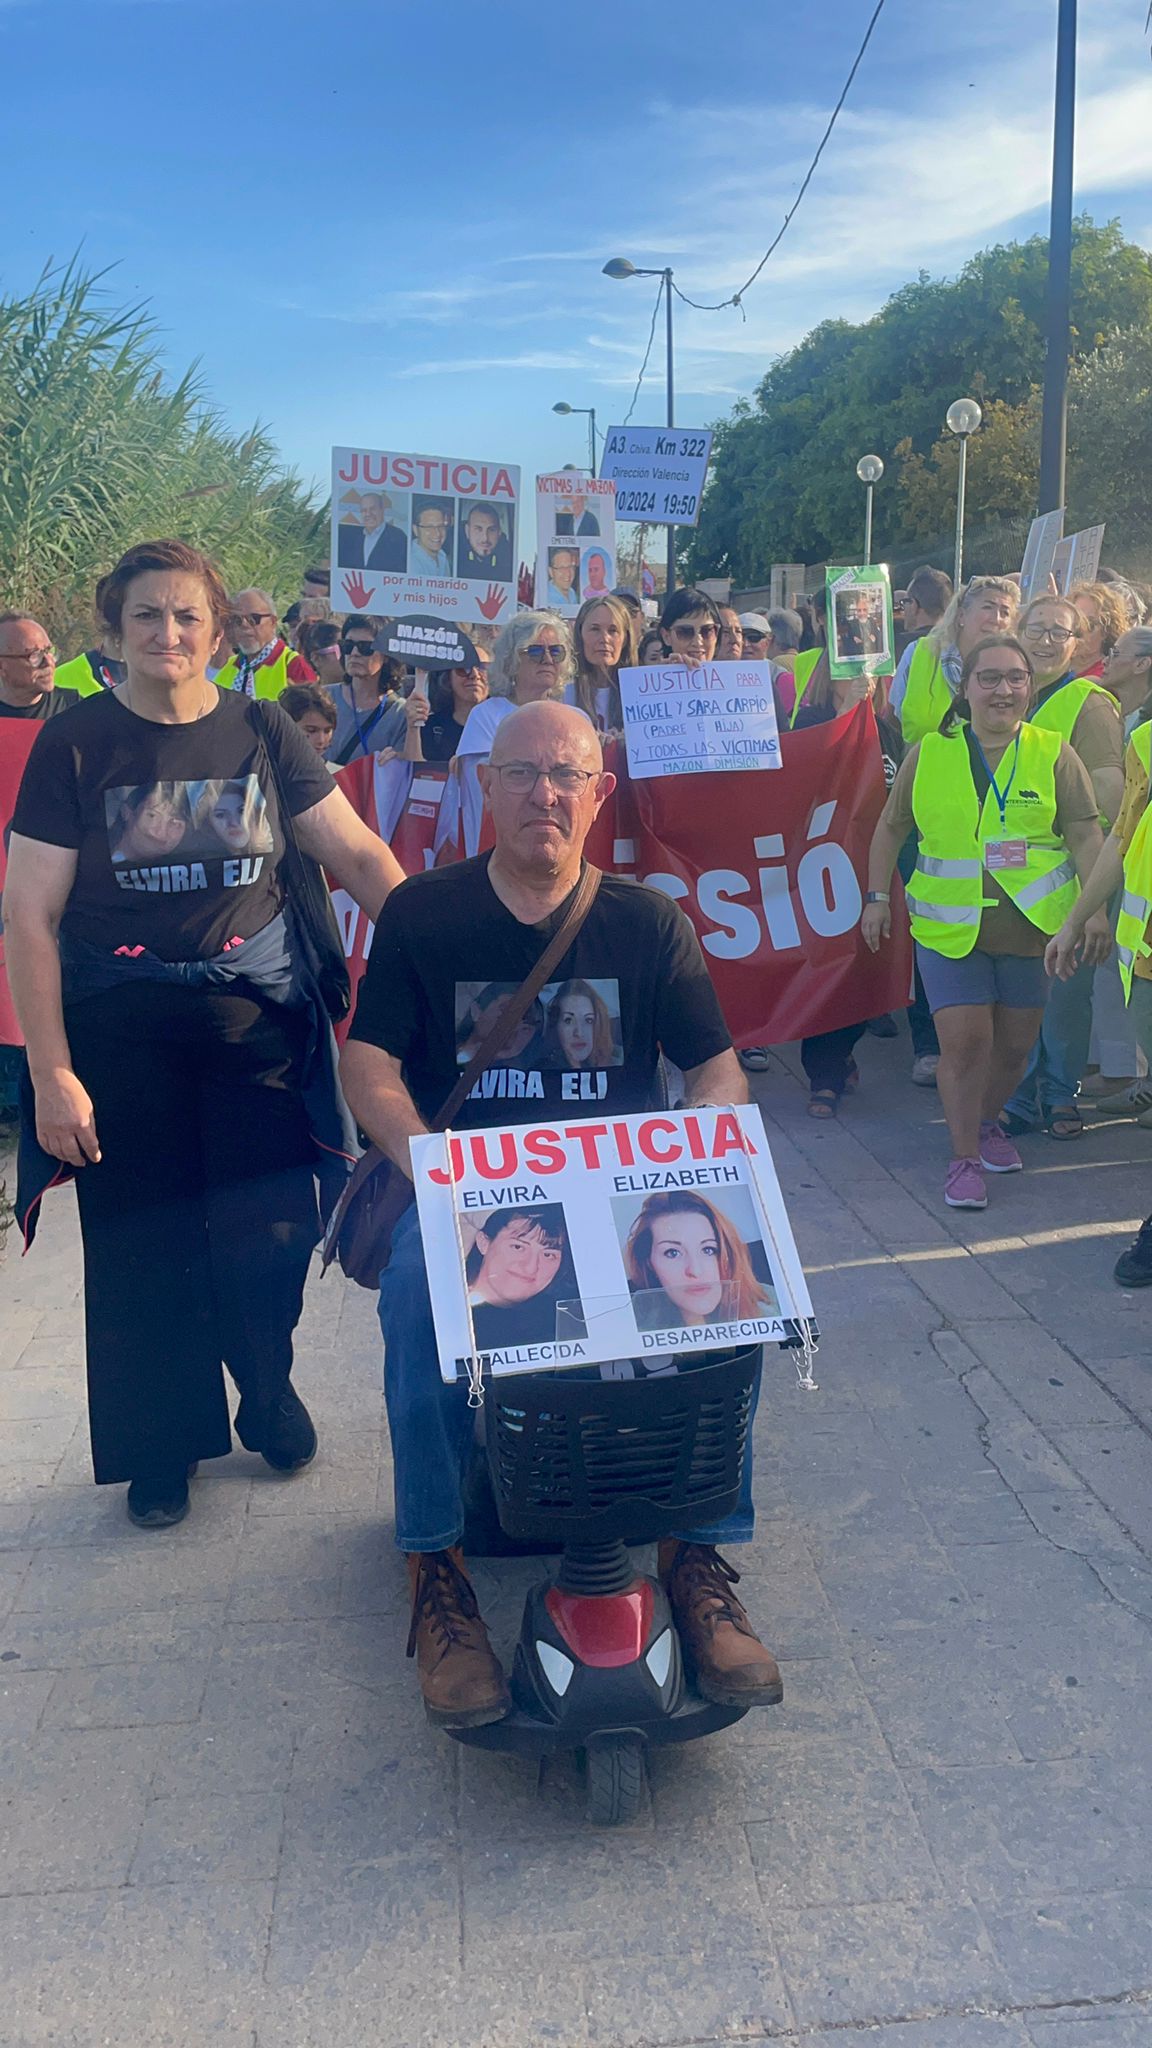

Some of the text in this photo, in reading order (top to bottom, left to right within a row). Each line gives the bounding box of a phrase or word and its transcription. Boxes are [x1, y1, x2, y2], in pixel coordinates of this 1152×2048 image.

[655, 437, 676, 456] Km
[680, 439, 706, 458] 322
[338, 453, 516, 498] JUSTICIA
[612, 467, 690, 482] Dirección Valencia
[663, 494, 697, 516] 19:50
[383, 576, 469, 591] por mi marido
[393, 592, 458, 607] y mis hijos
[397, 624, 458, 645] MAZÓN
[388, 639, 465, 662] DIMISSIÓ
[737, 672, 762, 686] PARA
[687, 699, 722, 716] SARA
[643, 723, 687, 740] (PADRE
[697, 722, 704, 733] E
[648, 743, 688, 759] TODAS
[694, 741, 716, 754] LAS
[115, 857, 264, 893] ELVIRA ELI
[460, 1069, 608, 1100] LVIRA ELI
[427, 1113, 758, 1185] JUSTICIA
[613, 1166, 740, 1193] ELIZABETH
[463, 1184, 548, 1208] ELVIRA
[642, 1320, 784, 1348] DESAPARECIDA
